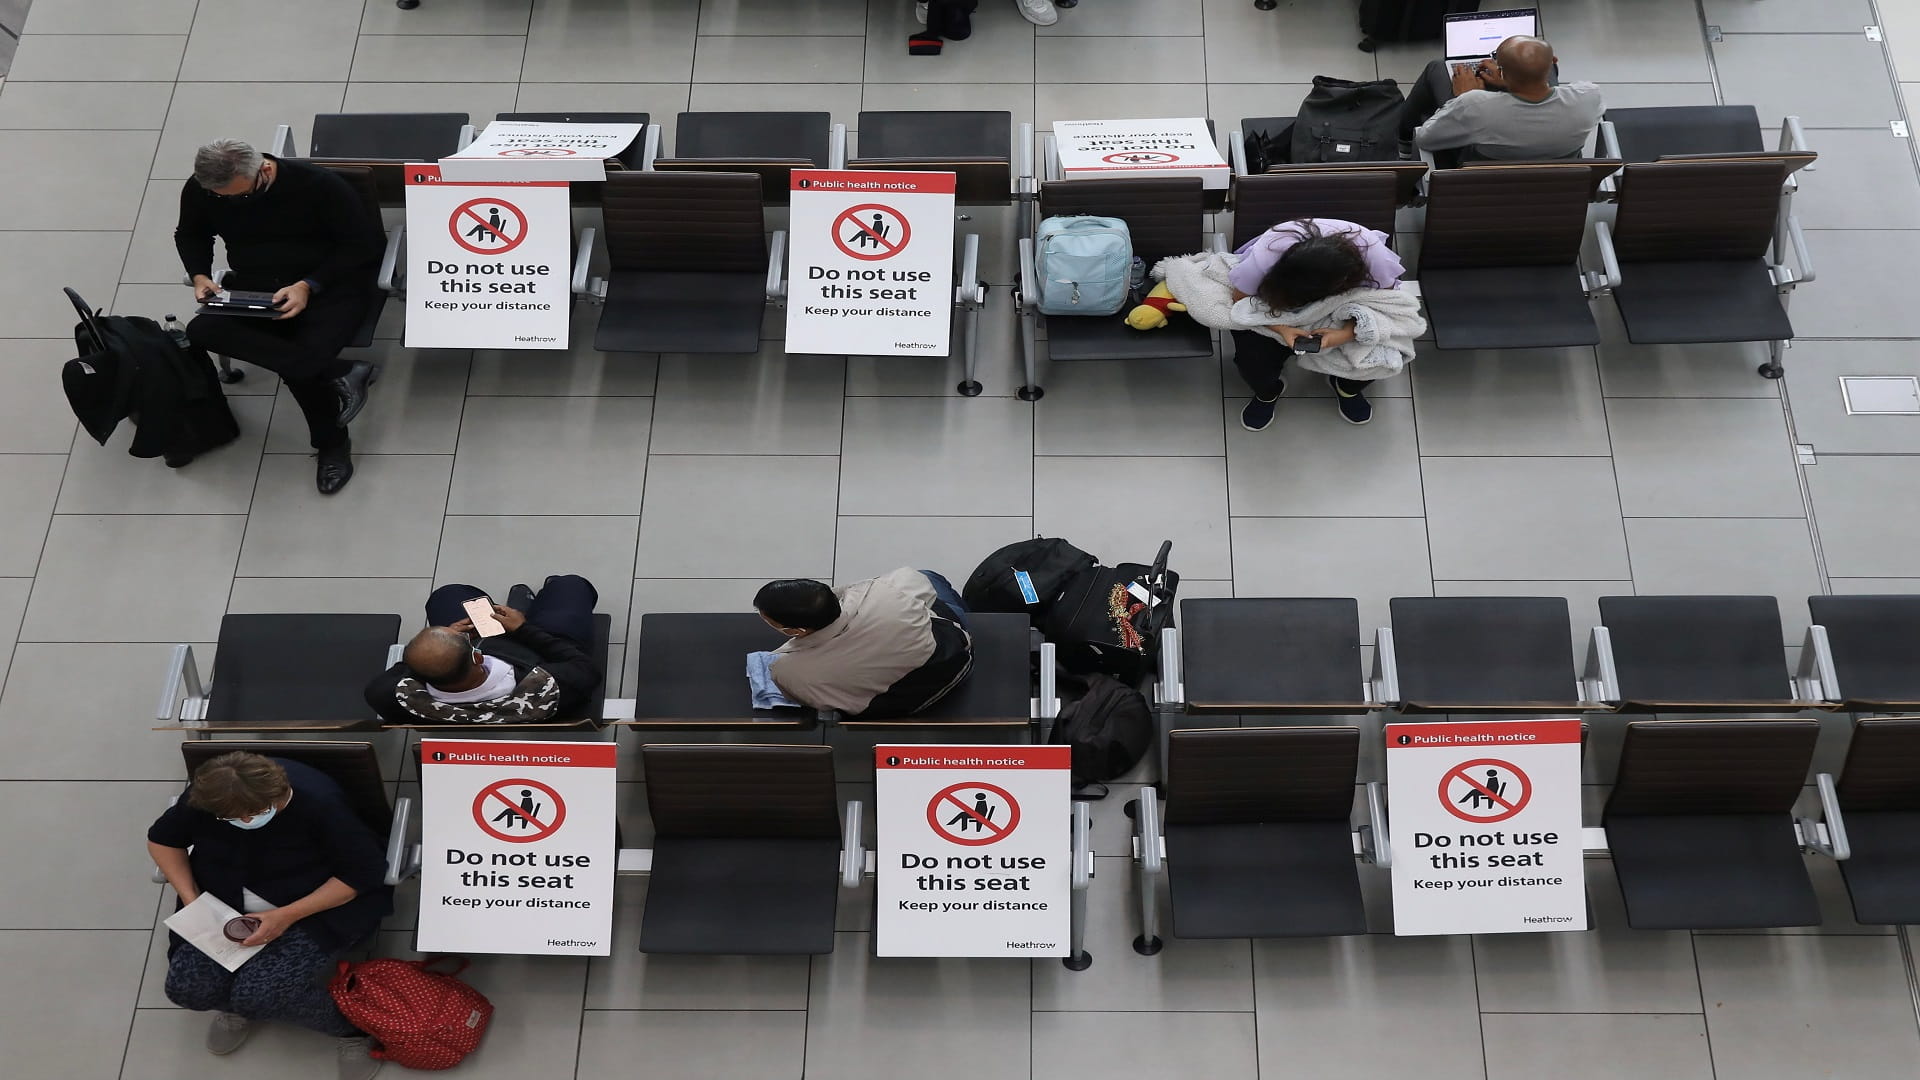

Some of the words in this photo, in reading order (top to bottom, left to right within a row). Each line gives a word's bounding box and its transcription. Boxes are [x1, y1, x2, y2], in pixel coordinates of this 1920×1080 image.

[813, 180, 845, 189] Public
[847, 181, 880, 190] health
[884, 182, 917, 190] notice
[427, 261, 460, 275] Do
[466, 263, 505, 275] not
[511, 264, 550, 275] use
[808, 266, 840, 280] Do
[847, 268, 885, 281] not
[892, 270, 931, 282] use
[440, 279, 482, 293] this
[488, 280, 536, 294] seat
[821, 285, 863, 299] this
[869, 287, 917, 300] seat
[424, 301, 458, 311] Keep
[461, 302, 493, 311] your
[496, 301, 551, 311] distance
[805, 306, 839, 317] Keep
[841, 308, 873, 317] your
[876, 307, 932, 317] distance
[514, 335, 556, 343] Heathrow
[1414, 735, 1452, 744] Public
[1454, 734, 1494, 743] health
[1497, 733, 1536, 741] notice
[449, 753, 486, 761] Public
[489, 754, 529, 762] health
[532, 755, 571, 763] notice
[903, 757, 940, 765] Public
[944, 757, 983, 766] health
[987, 758, 1025, 766] notice
[1414, 832, 1451, 848] Do
[1459, 831, 1505, 846] not
[1513, 832, 1558, 845] use
[446, 849, 483, 865] Do
[491, 852, 537, 866] not
[545, 855, 590, 868] use
[901, 853, 939, 869] Do
[947, 854, 993, 869] not
[1000, 856, 1046, 869] use
[1430, 852, 1480, 869] this
[1488, 851, 1544, 868] seat
[460, 871, 510, 887] this
[518, 874, 574, 889] seat
[916, 874, 966, 891] this
[974, 875, 1030, 891] seat
[1414, 879, 1453, 890] Keep
[1457, 879, 1494, 890] your
[1498, 876, 1563, 887] distance
[442, 896, 482, 908] Keep
[485, 898, 522, 909] your
[526, 898, 591, 909] distance
[899, 900, 939, 912] Keep
[942, 902, 980, 912] your
[983, 900, 1048, 911] distance
[1523, 916, 1573, 924] Heathrow
[547, 939, 597, 947] Heathrow
[1006, 941, 1056, 949] Heathrow
